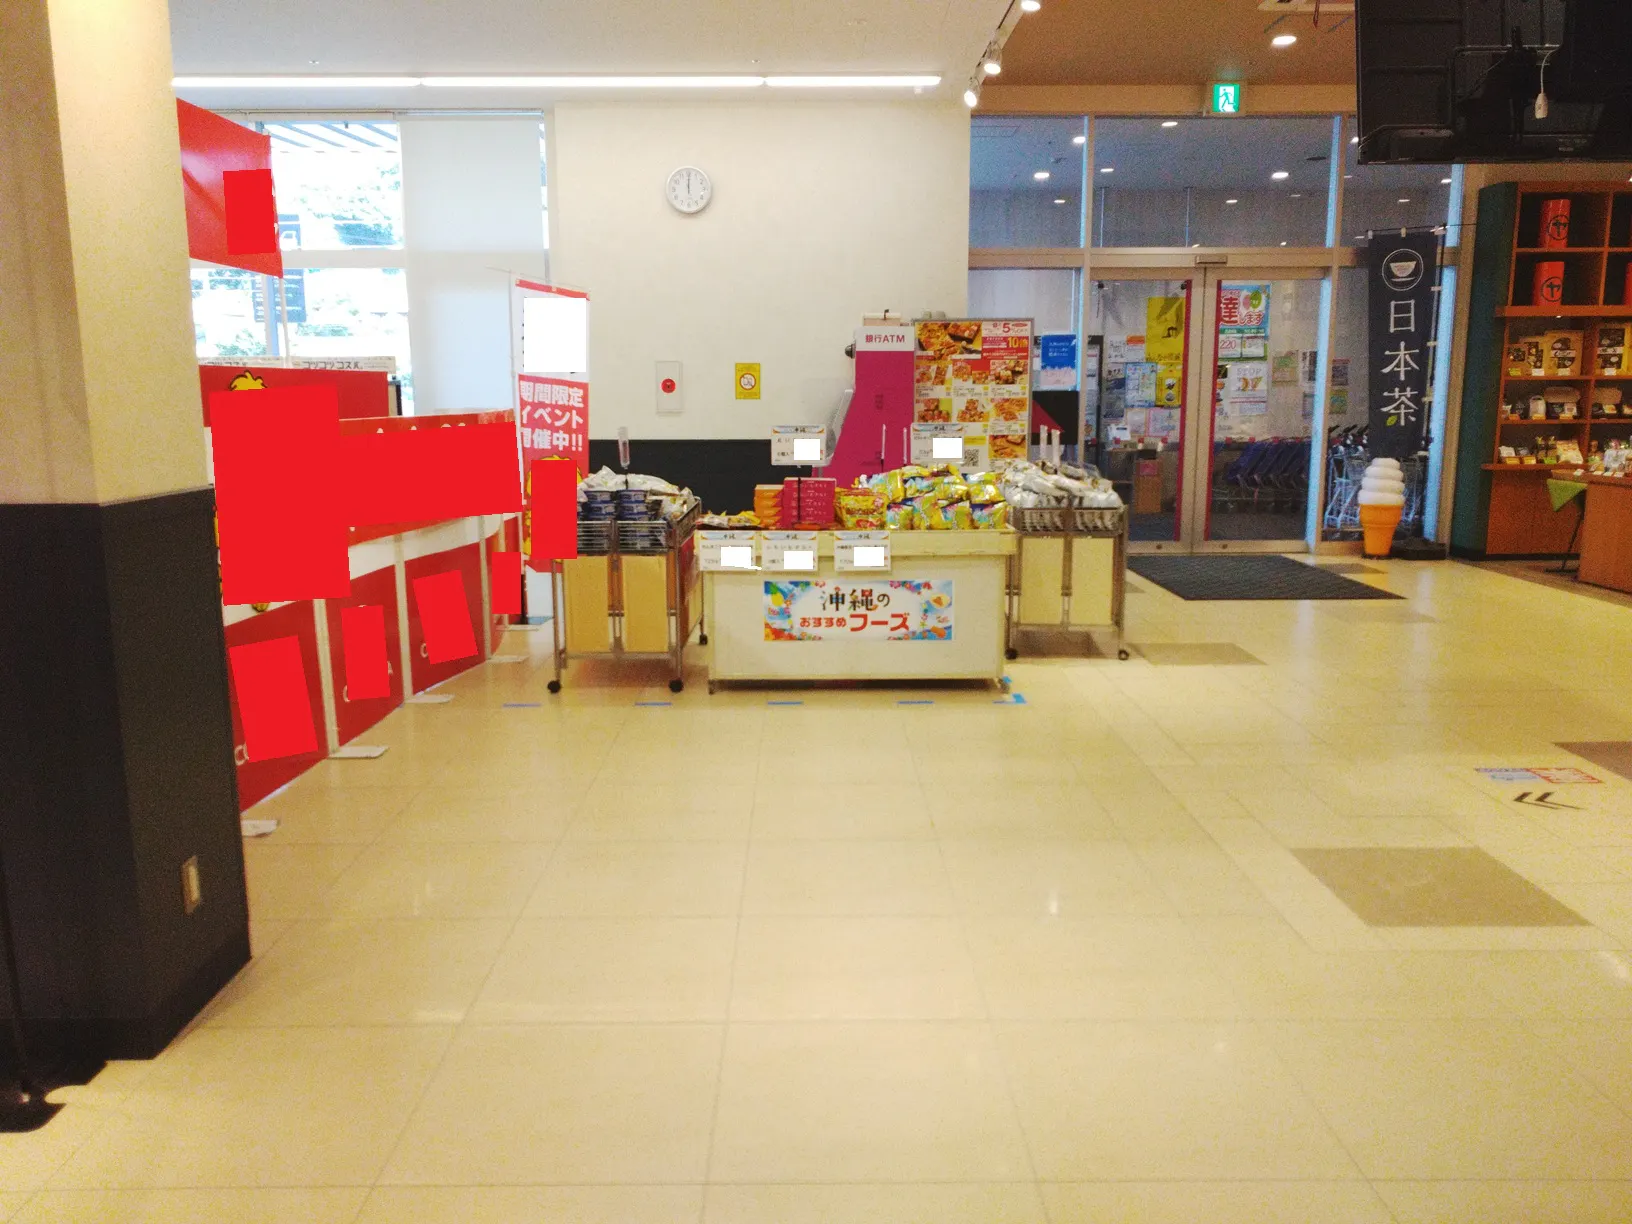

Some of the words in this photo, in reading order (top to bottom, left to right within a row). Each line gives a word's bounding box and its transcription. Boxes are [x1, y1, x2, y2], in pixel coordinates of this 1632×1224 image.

[865, 334, 905, 344] 銀行ATM
[1380, 299, 1420, 427] 日本茶
[519, 380, 584, 408] 期間限定
[521, 405, 584, 430] イベント
[820, 587, 891, 611] 沖縄の
